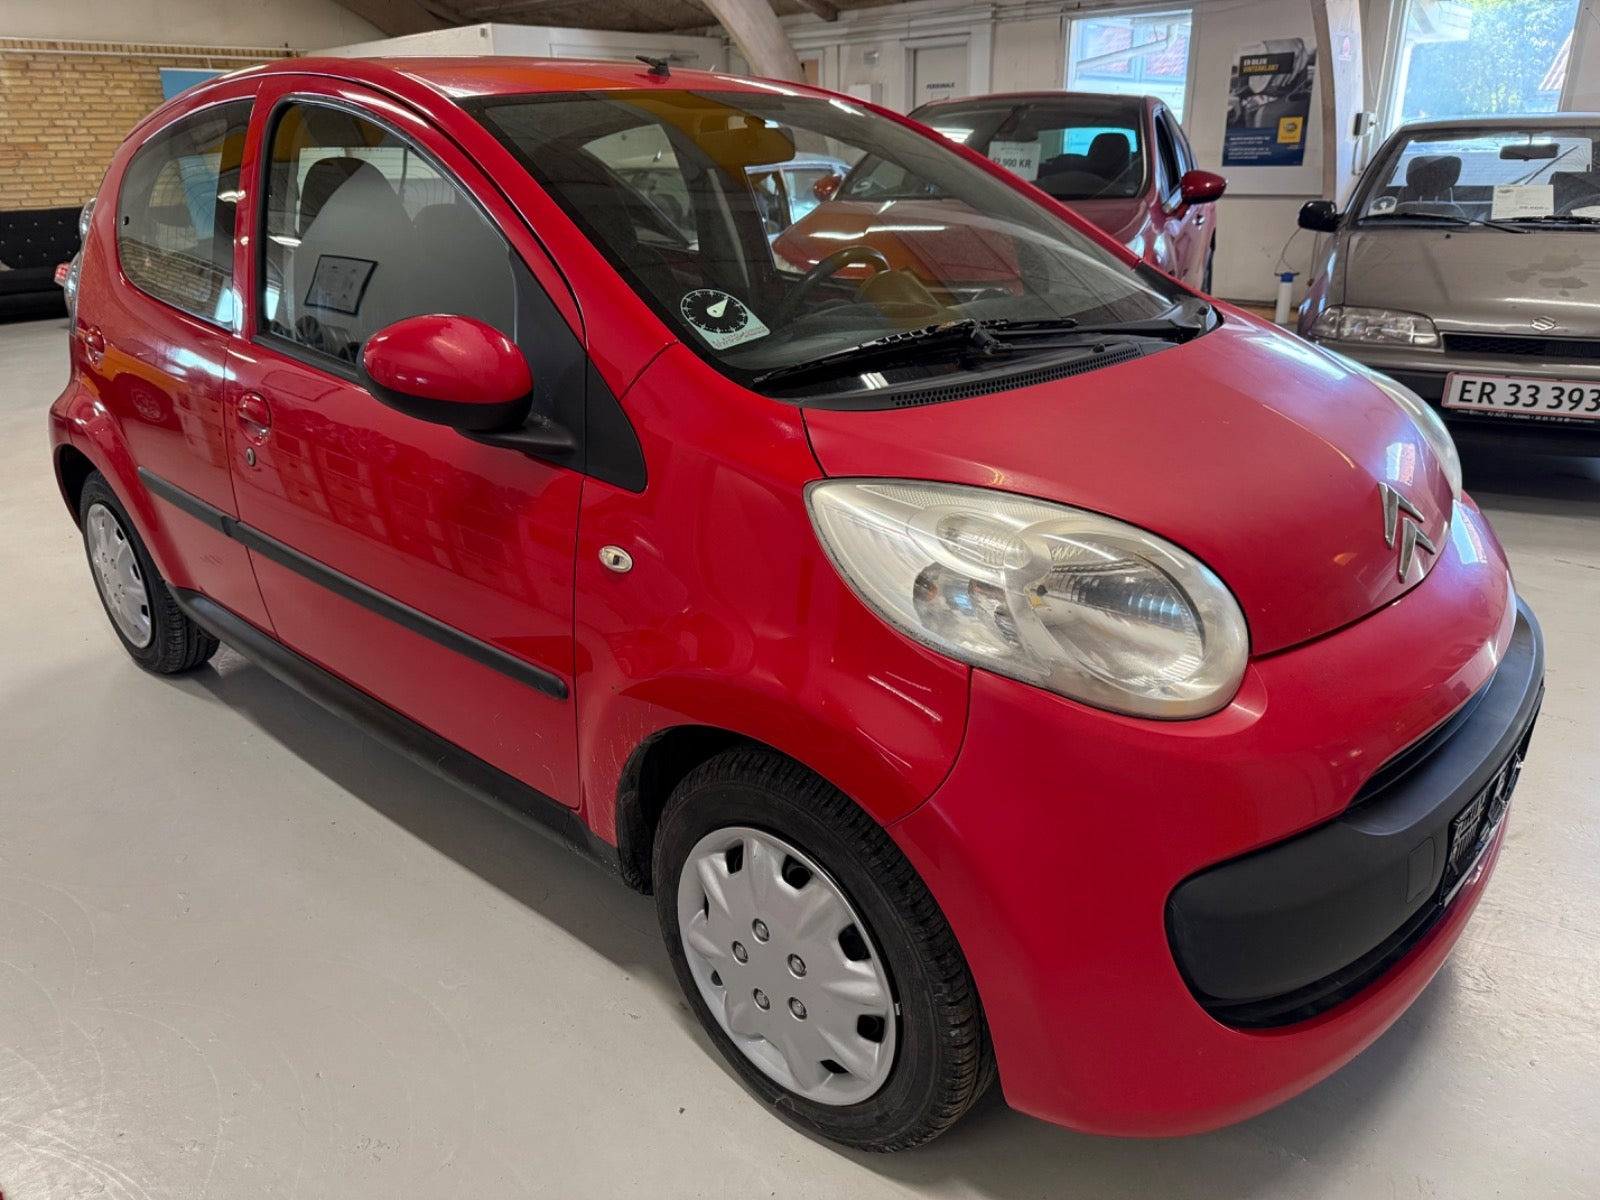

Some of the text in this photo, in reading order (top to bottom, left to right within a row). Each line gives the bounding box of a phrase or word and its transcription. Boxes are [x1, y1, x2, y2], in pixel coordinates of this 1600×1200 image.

[1019, 158, 1032, 169] KR
[1458, 380, 1600, 412] ER 33 393
